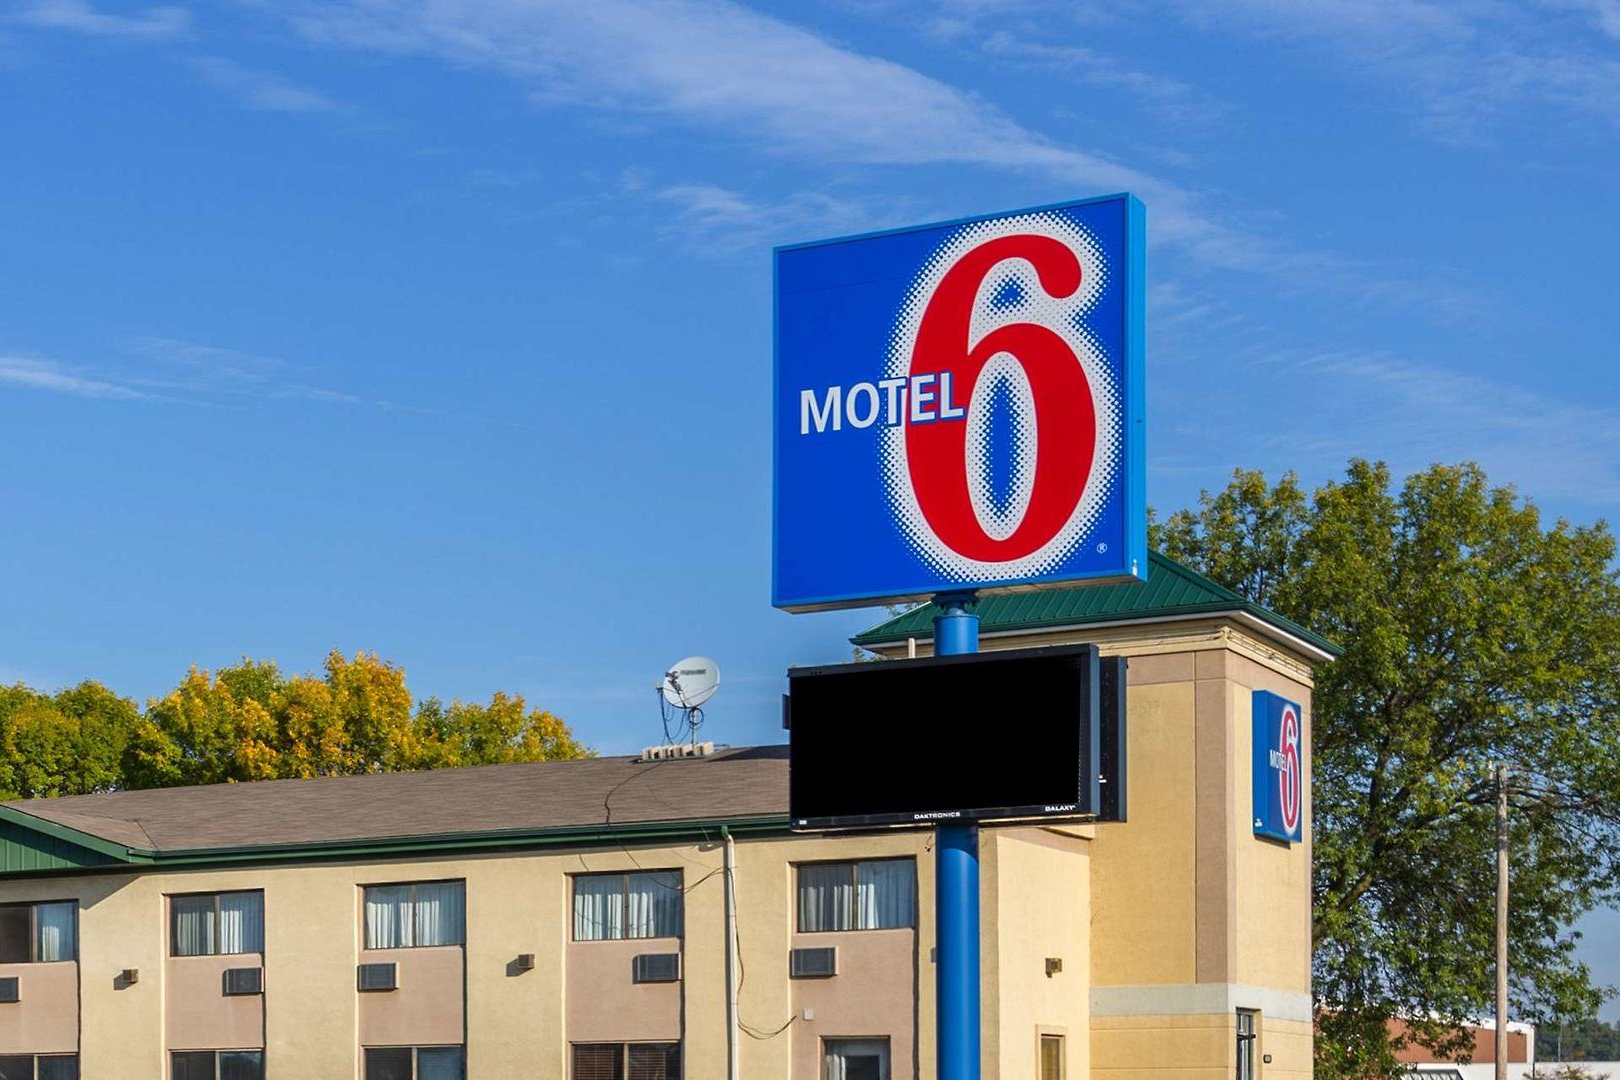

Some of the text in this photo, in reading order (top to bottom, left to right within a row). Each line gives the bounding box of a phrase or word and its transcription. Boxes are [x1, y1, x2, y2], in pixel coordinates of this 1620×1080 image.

[800, 232, 1097, 564] MOTEL 6
[913, 811, 961, 820] DAKTRONICS
[1280, 709, 1299, 829] 6
